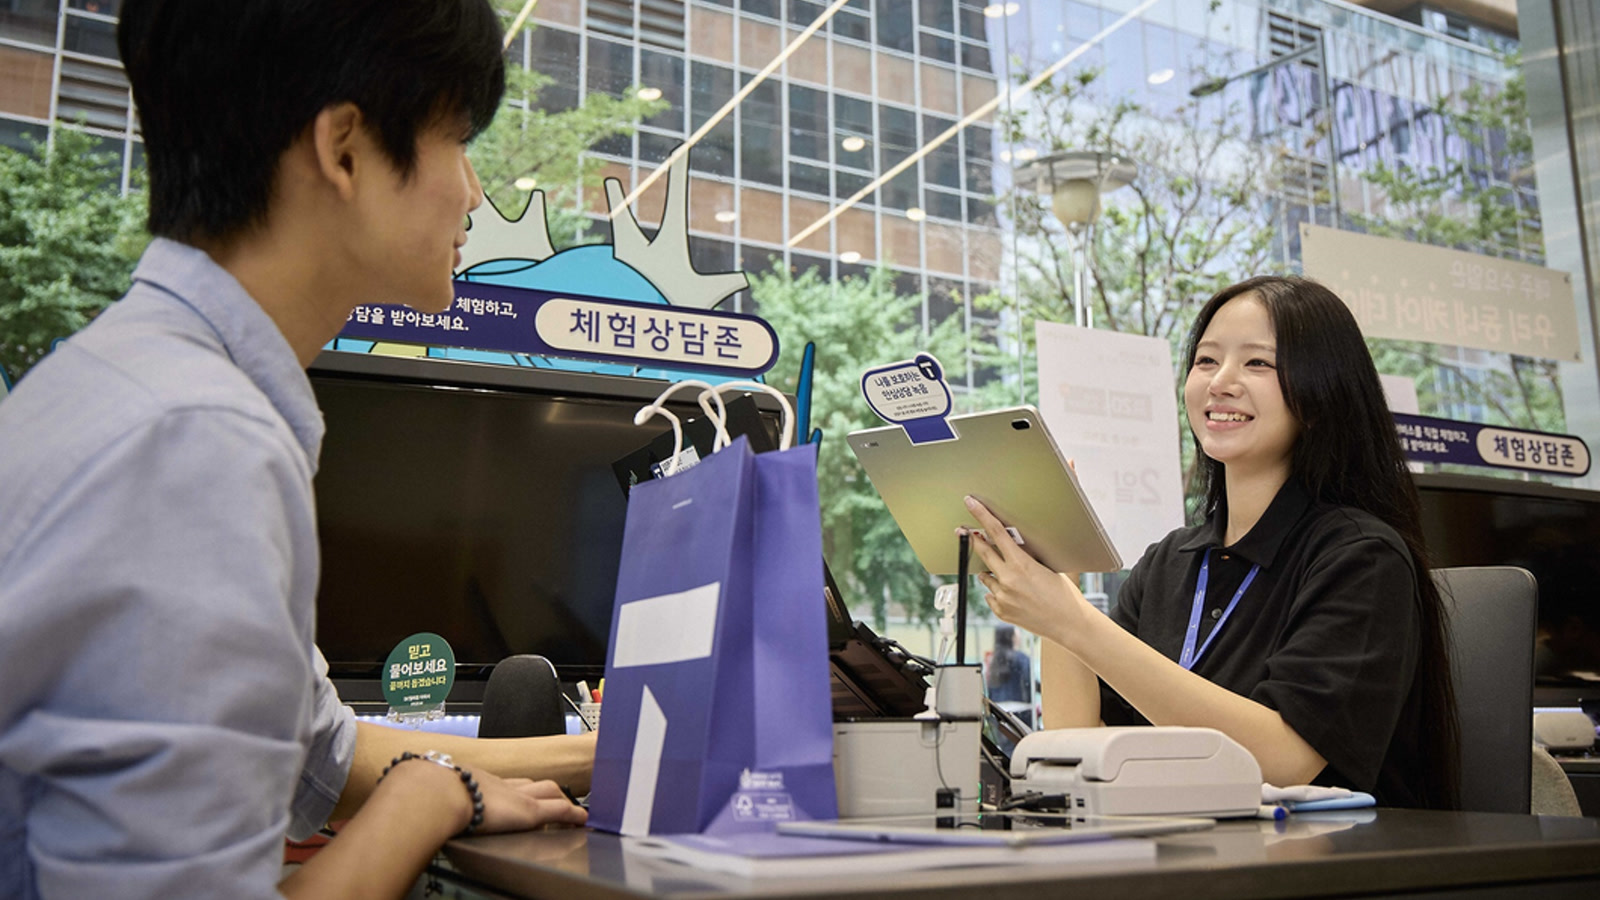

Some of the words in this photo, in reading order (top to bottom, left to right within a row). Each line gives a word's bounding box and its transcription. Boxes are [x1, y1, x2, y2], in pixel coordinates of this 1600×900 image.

[456, 296, 518, 319] 체험하고,
[390, 309, 470, 331] 받아보세요.
[569, 307, 742, 360] 체험상담존
[1493, 434, 1575, 468] 체험상담존
[408, 644, 431, 660] 믿고
[389, 658, 447, 679] 물어보세요
[411, 675, 446, 688] 돕겠습니다
